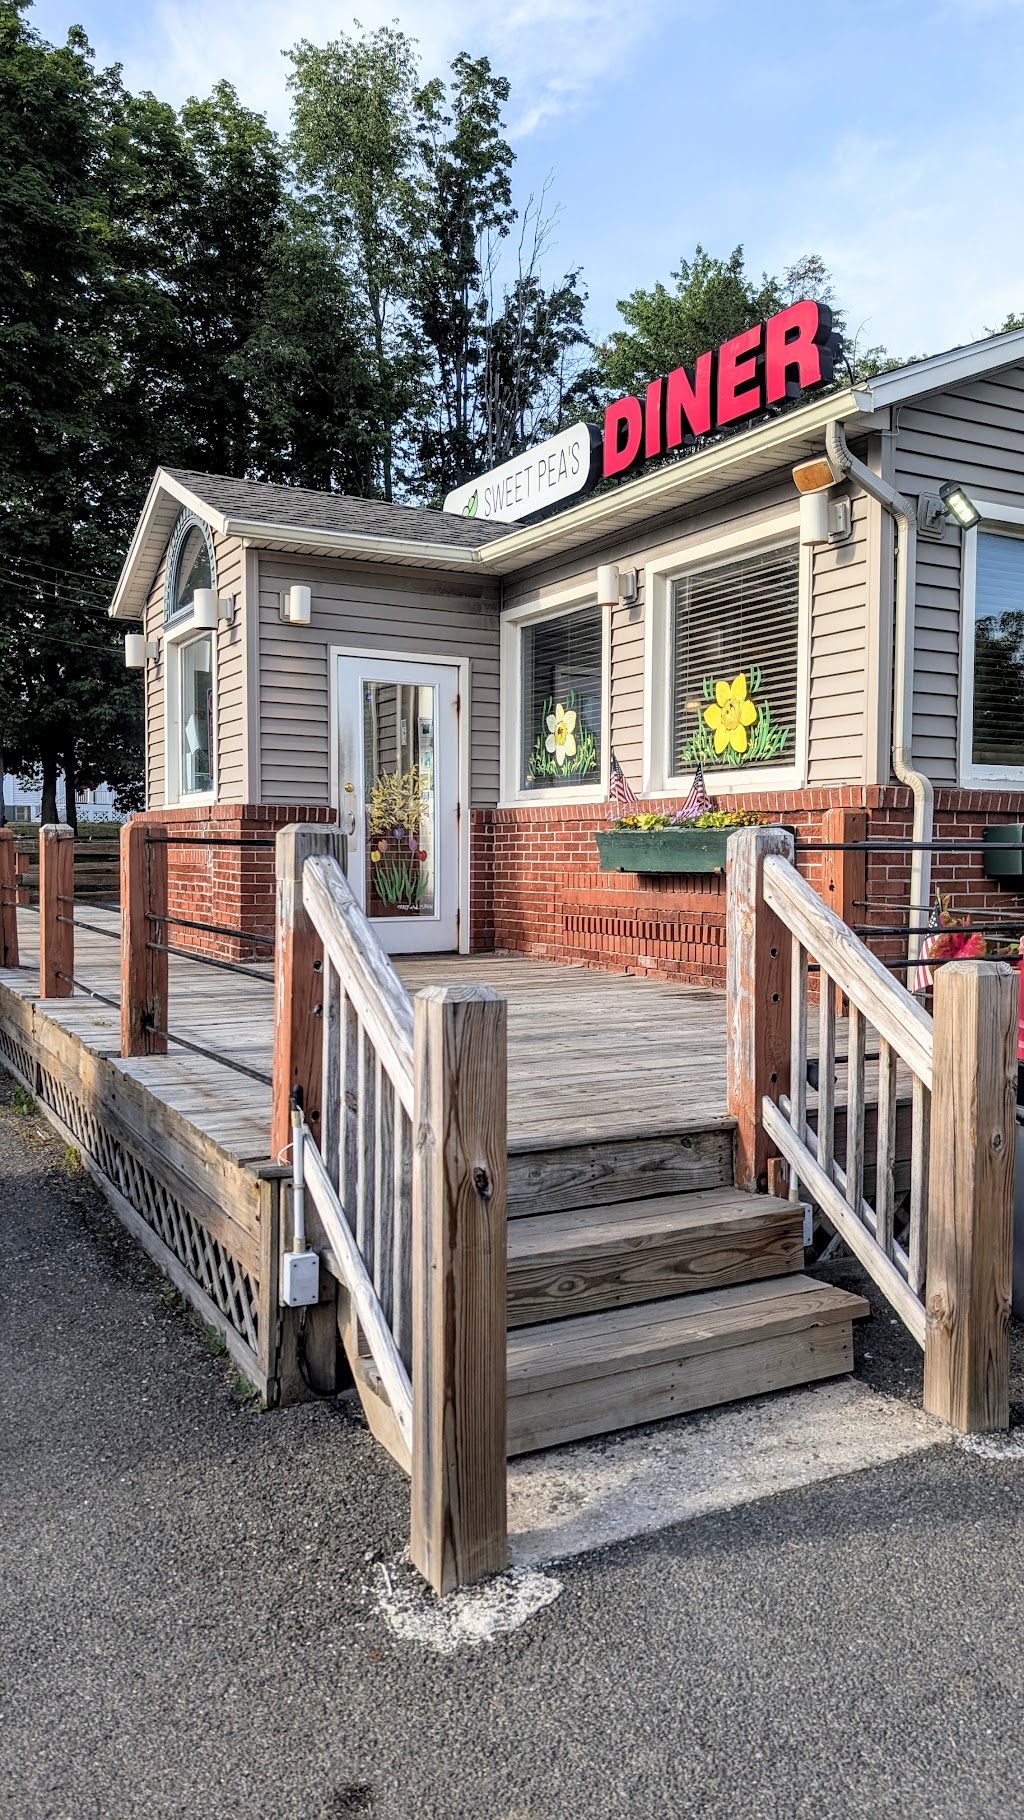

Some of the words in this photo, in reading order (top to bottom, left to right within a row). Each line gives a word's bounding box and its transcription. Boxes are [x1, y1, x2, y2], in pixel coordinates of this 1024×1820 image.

[603, 300, 822, 478] DINER
[484, 465, 533, 517] SWEET
[538, 441, 580, 493] PEA'S
